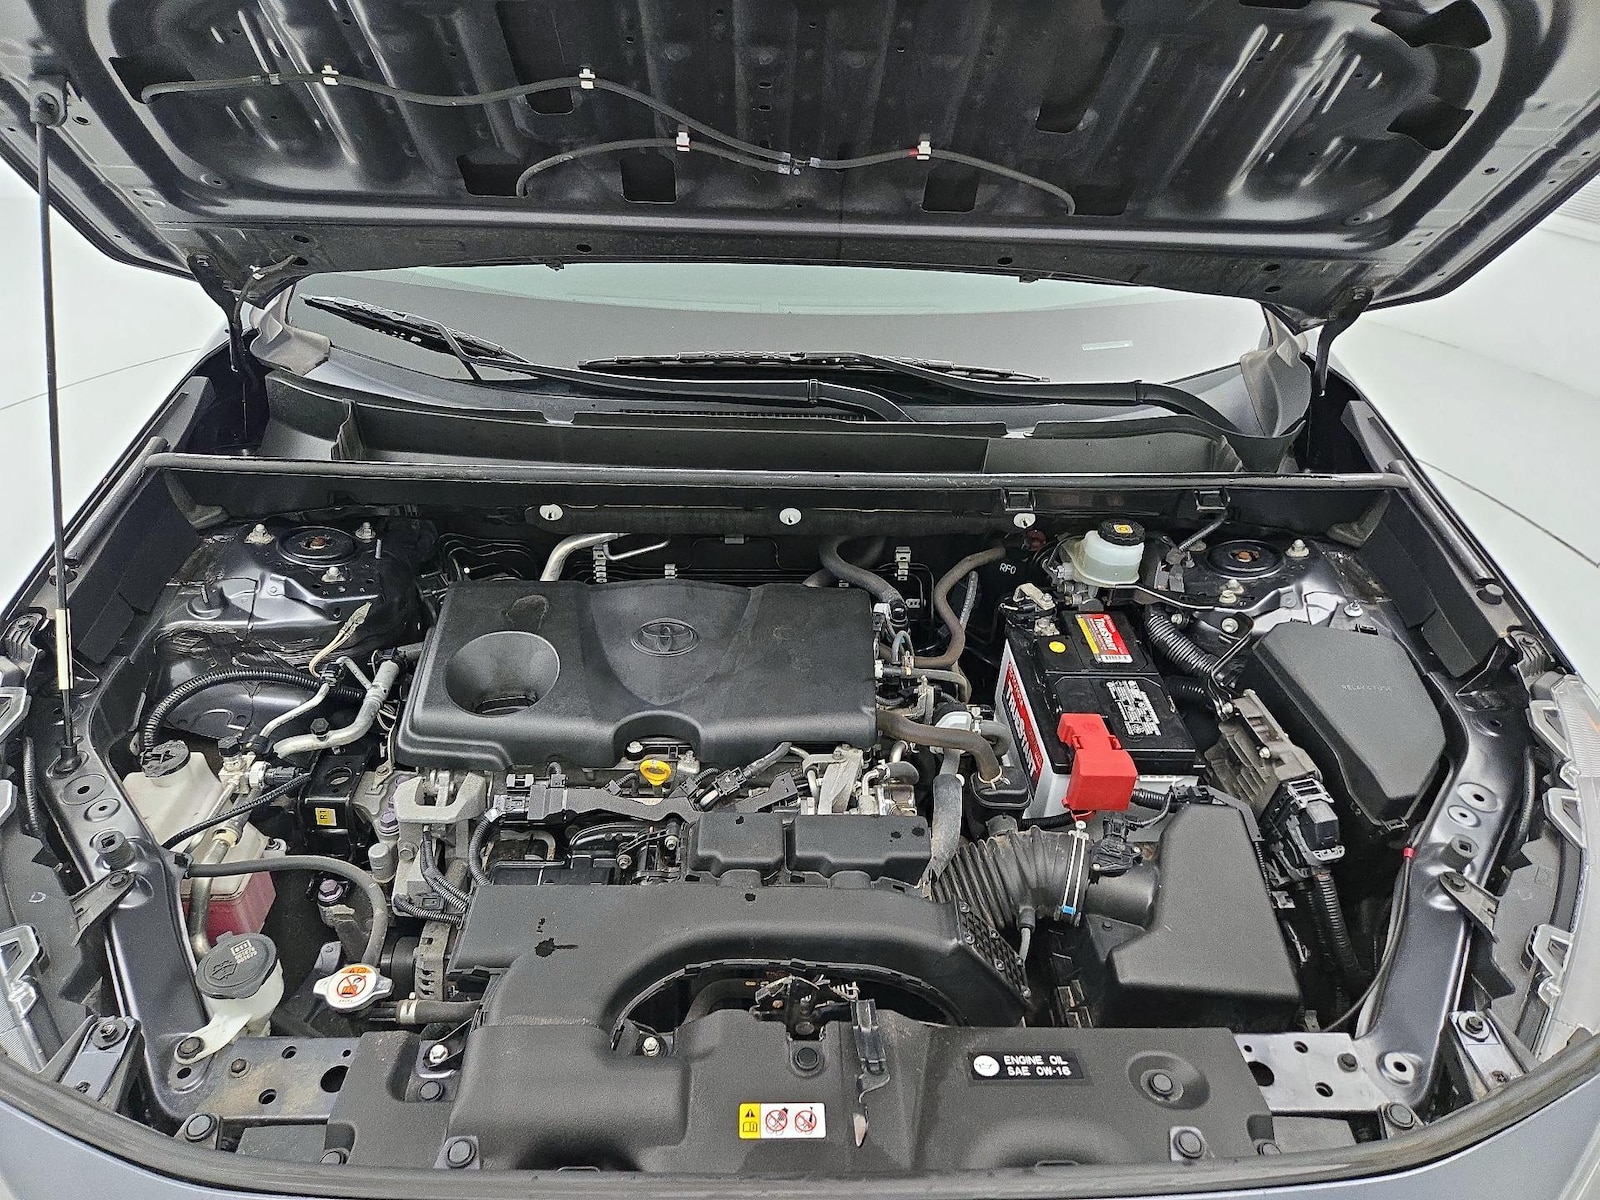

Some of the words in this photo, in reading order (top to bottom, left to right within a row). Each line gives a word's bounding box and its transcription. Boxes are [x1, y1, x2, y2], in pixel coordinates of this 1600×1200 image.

[1003, 1055, 1044, 1065] ENGINE
[1049, 1055, 1069, 1065] OIL
[1007, 1066, 1031, 1076] SAE
[1036, 1066, 1072, 1076] 0W-16
